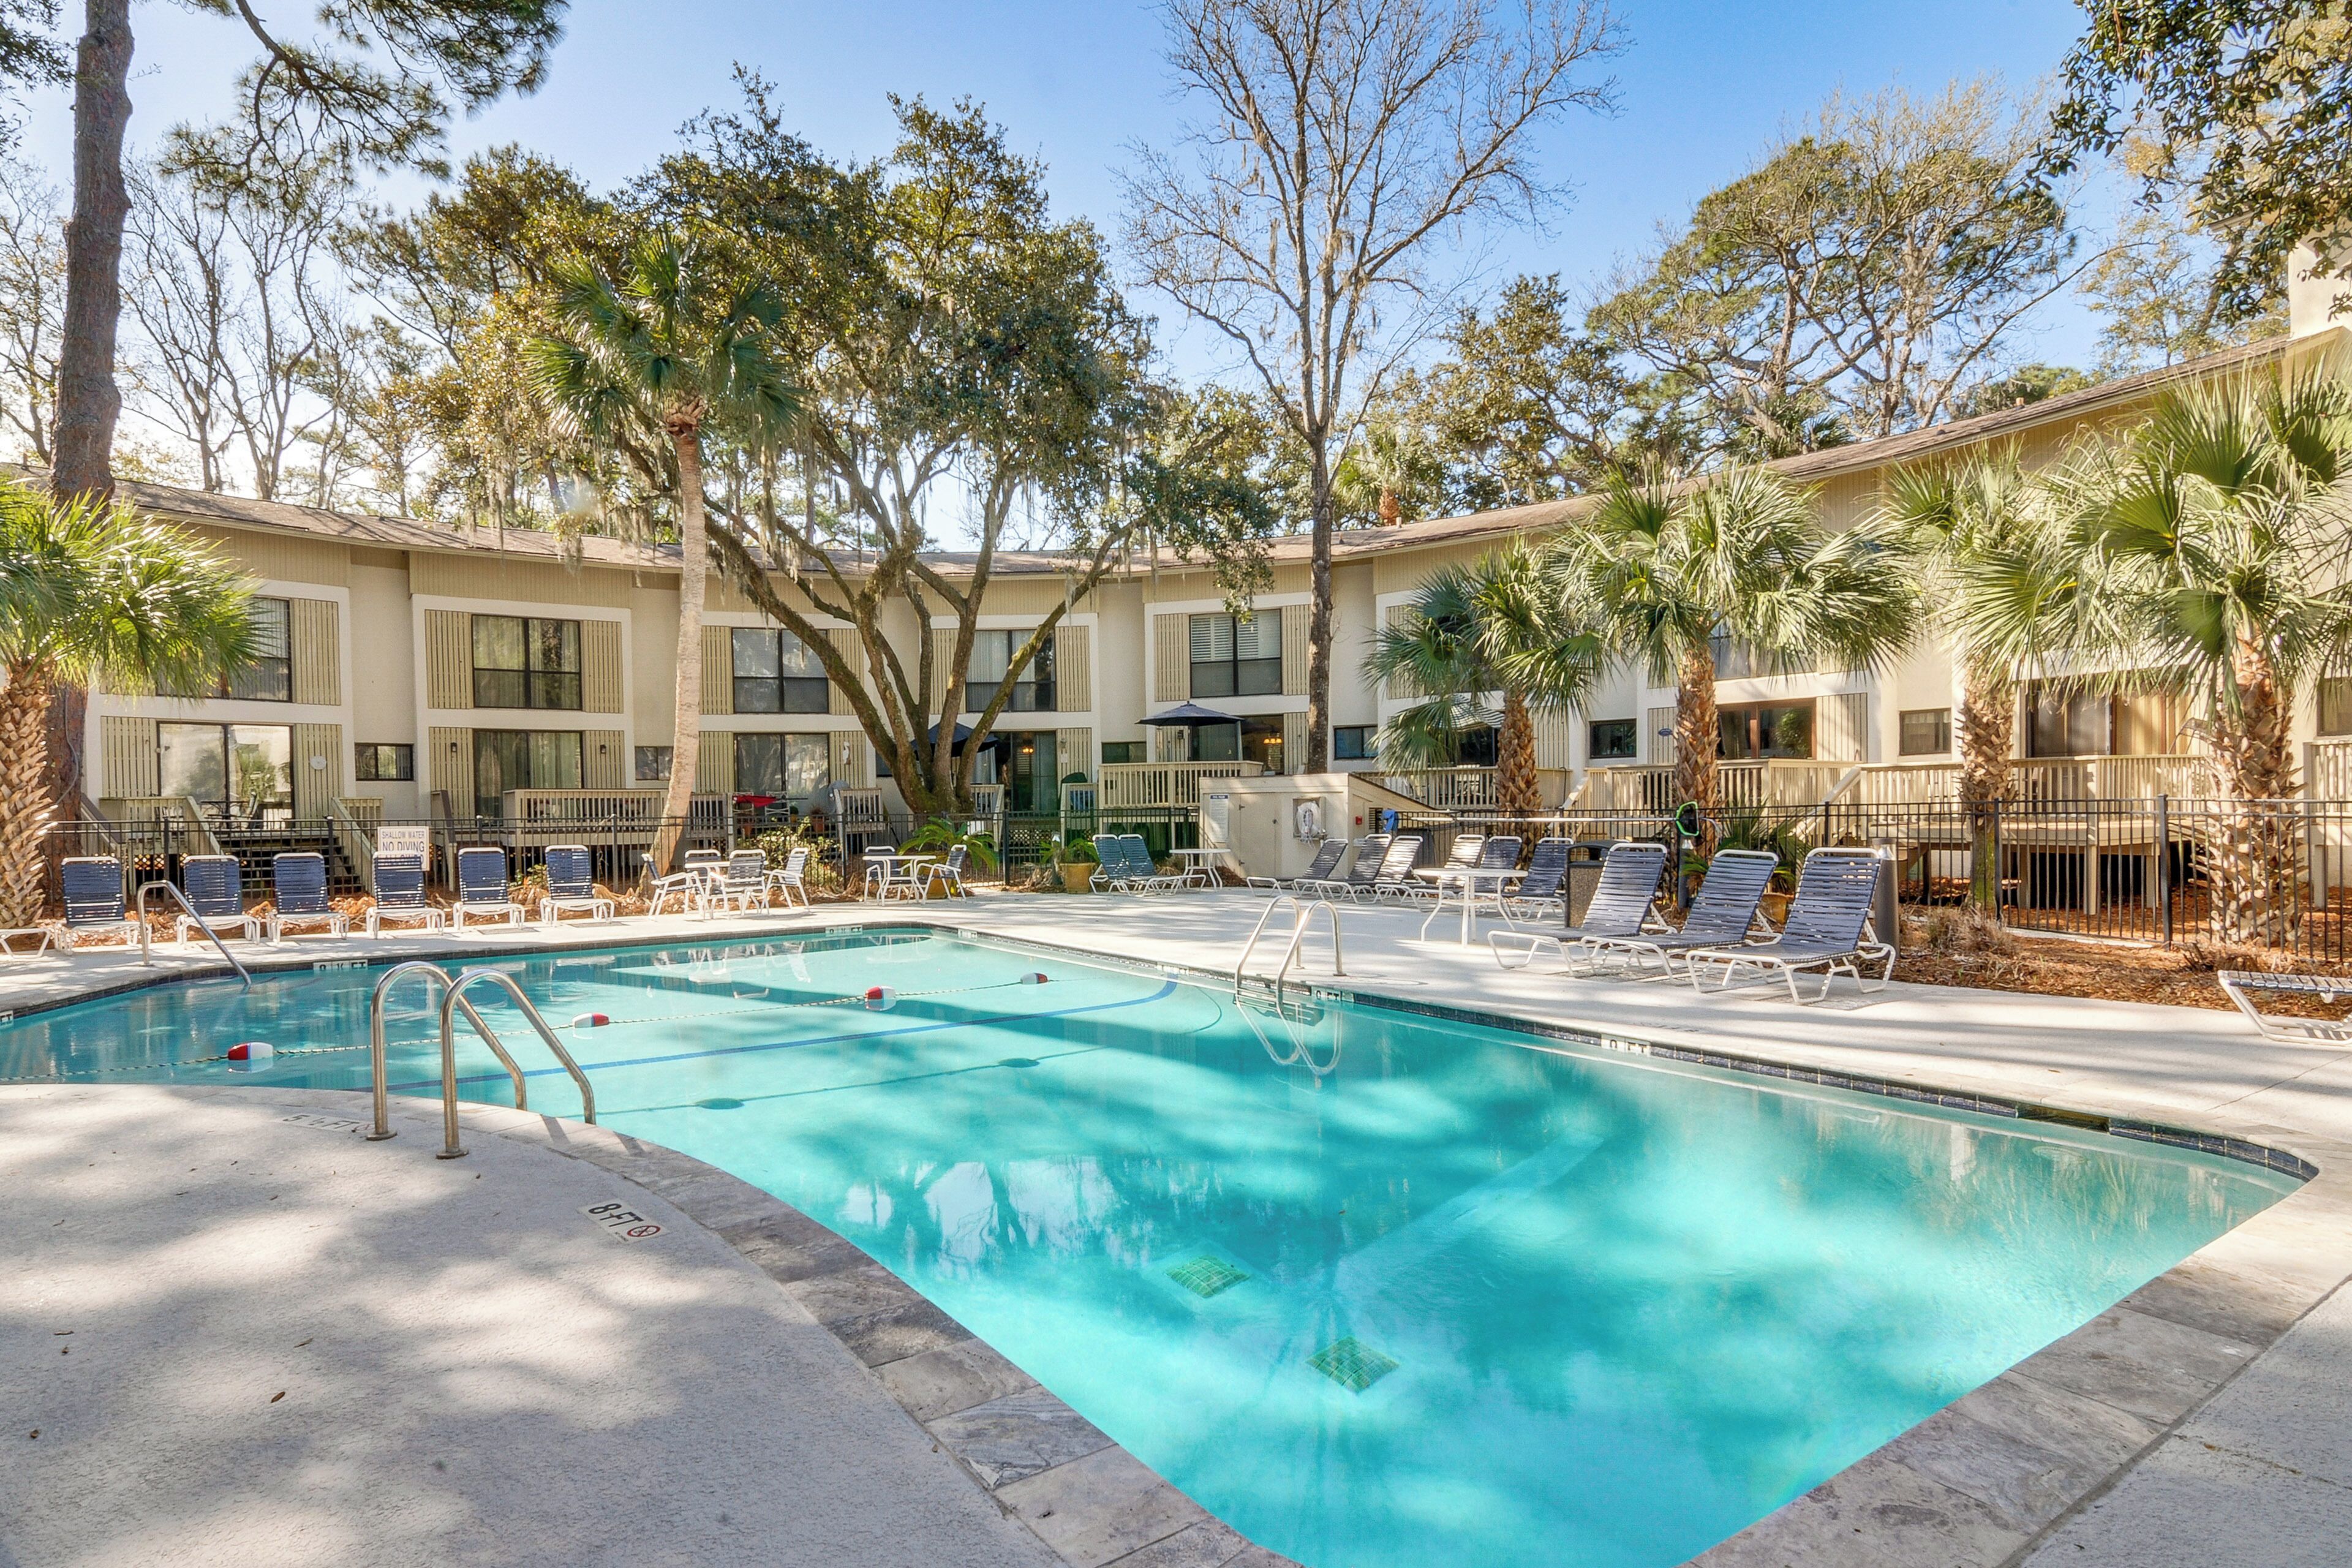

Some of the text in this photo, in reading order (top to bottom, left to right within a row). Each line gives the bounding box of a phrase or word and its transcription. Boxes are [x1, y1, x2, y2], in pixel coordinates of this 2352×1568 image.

[383, 841, 424, 852] NO DIVING
[322, 1120, 360, 1129] FT
[589, 1204, 644, 1227] 8 FT
